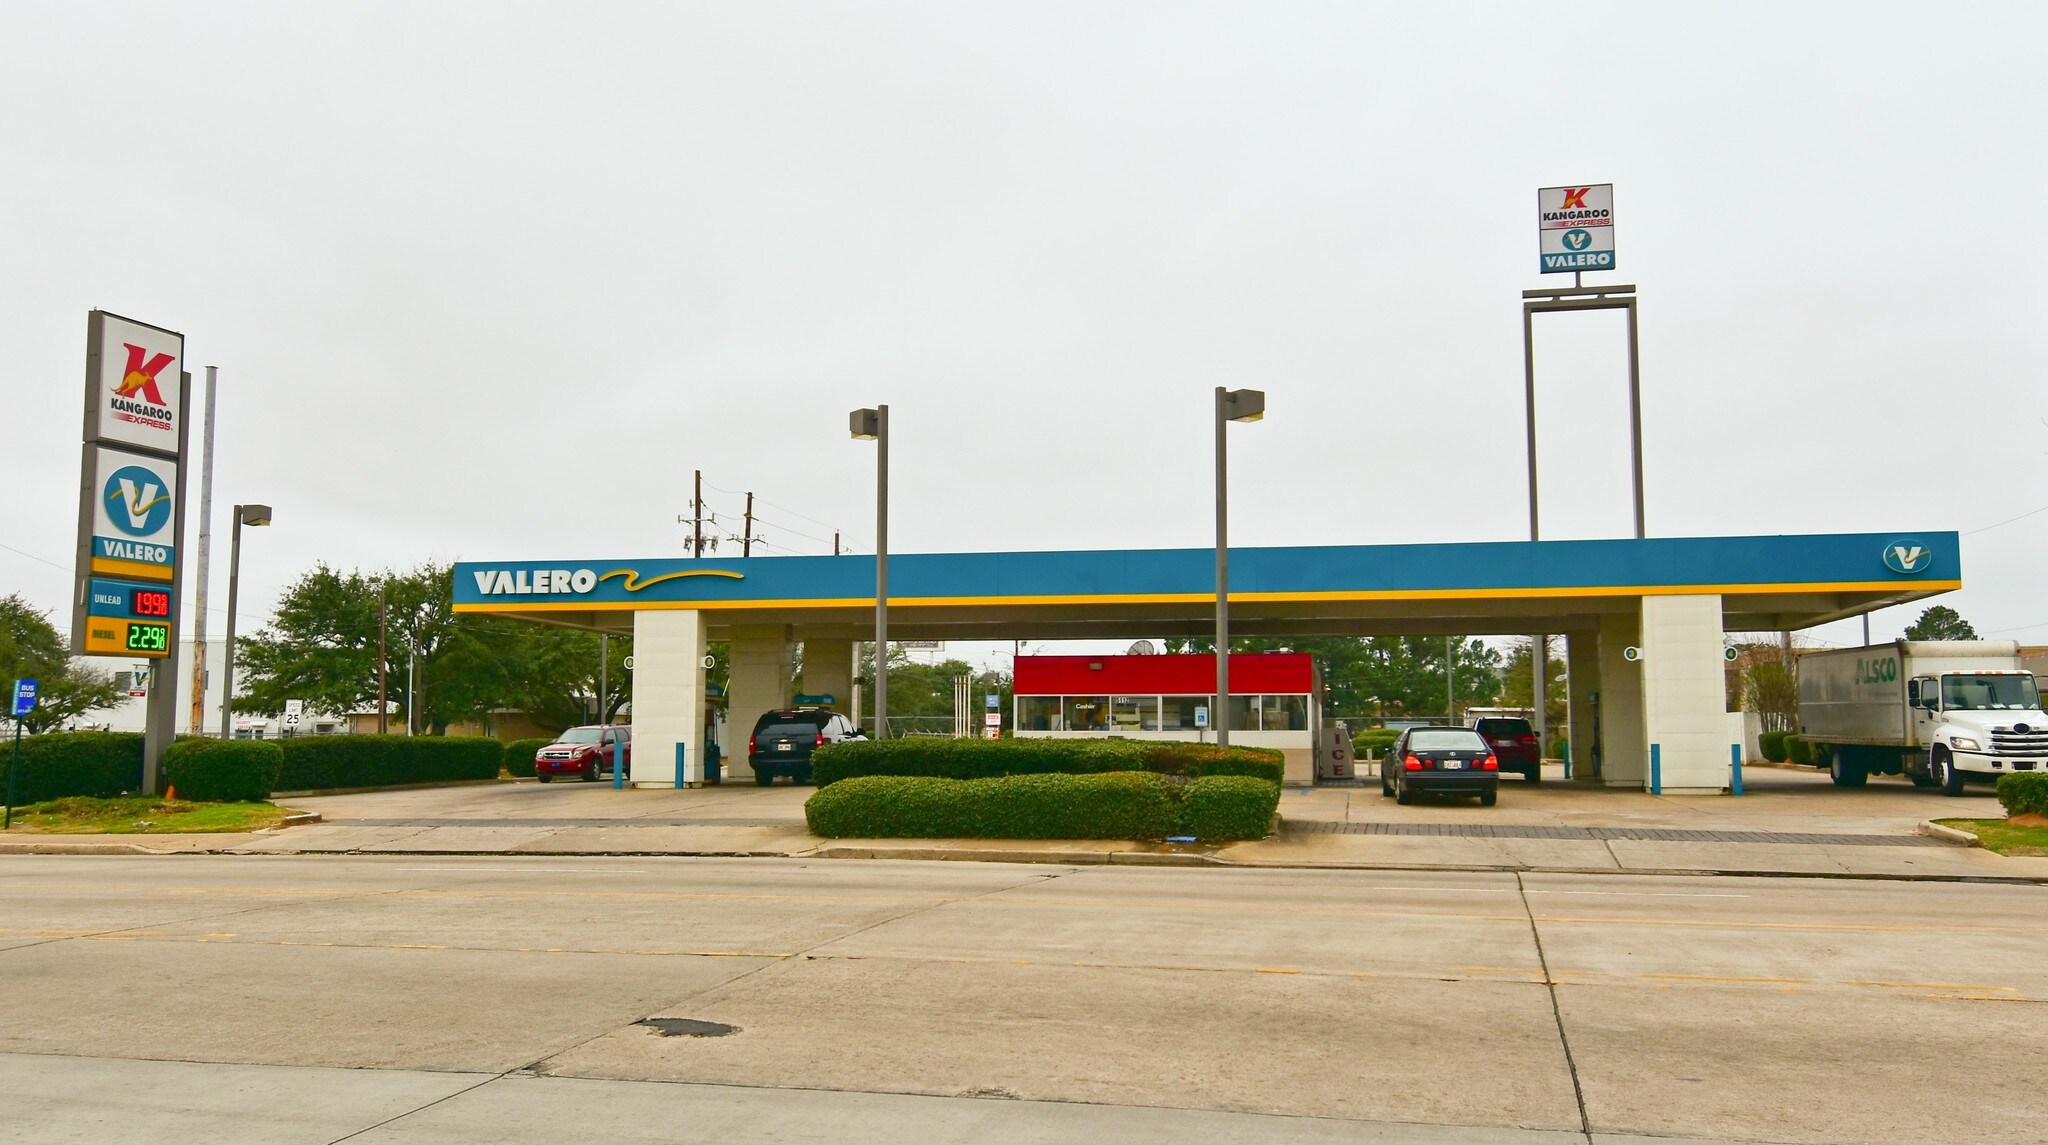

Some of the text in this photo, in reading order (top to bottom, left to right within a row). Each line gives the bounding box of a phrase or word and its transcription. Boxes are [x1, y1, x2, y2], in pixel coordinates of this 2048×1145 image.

[1561, 187, 1591, 209] K
[1543, 209, 1609, 221] KANGAROO
[1564, 218, 1610, 227] EXPRESS
[1568, 233, 1586, 249] V
[1545, 253, 1610, 267] VALERO
[115, 342, 175, 407] K
[111, 398, 172, 421] KANGAROO
[128, 414, 171, 431] EXPRESS
[118, 477, 159, 529] V
[103, 540, 167, 563] VALERO
[1894, 546, 1921, 569] V
[474, 569, 598, 594] VALERO
[94, 594, 121, 605] UNLEAD
[92, 629, 116, 640] DIESEL
[1629, 649, 1635, 657] 3
[1855, 656, 1897, 685] ALSCO
[286, 714, 299, 724] 25
[1332, 733, 1345, 776] ICE
